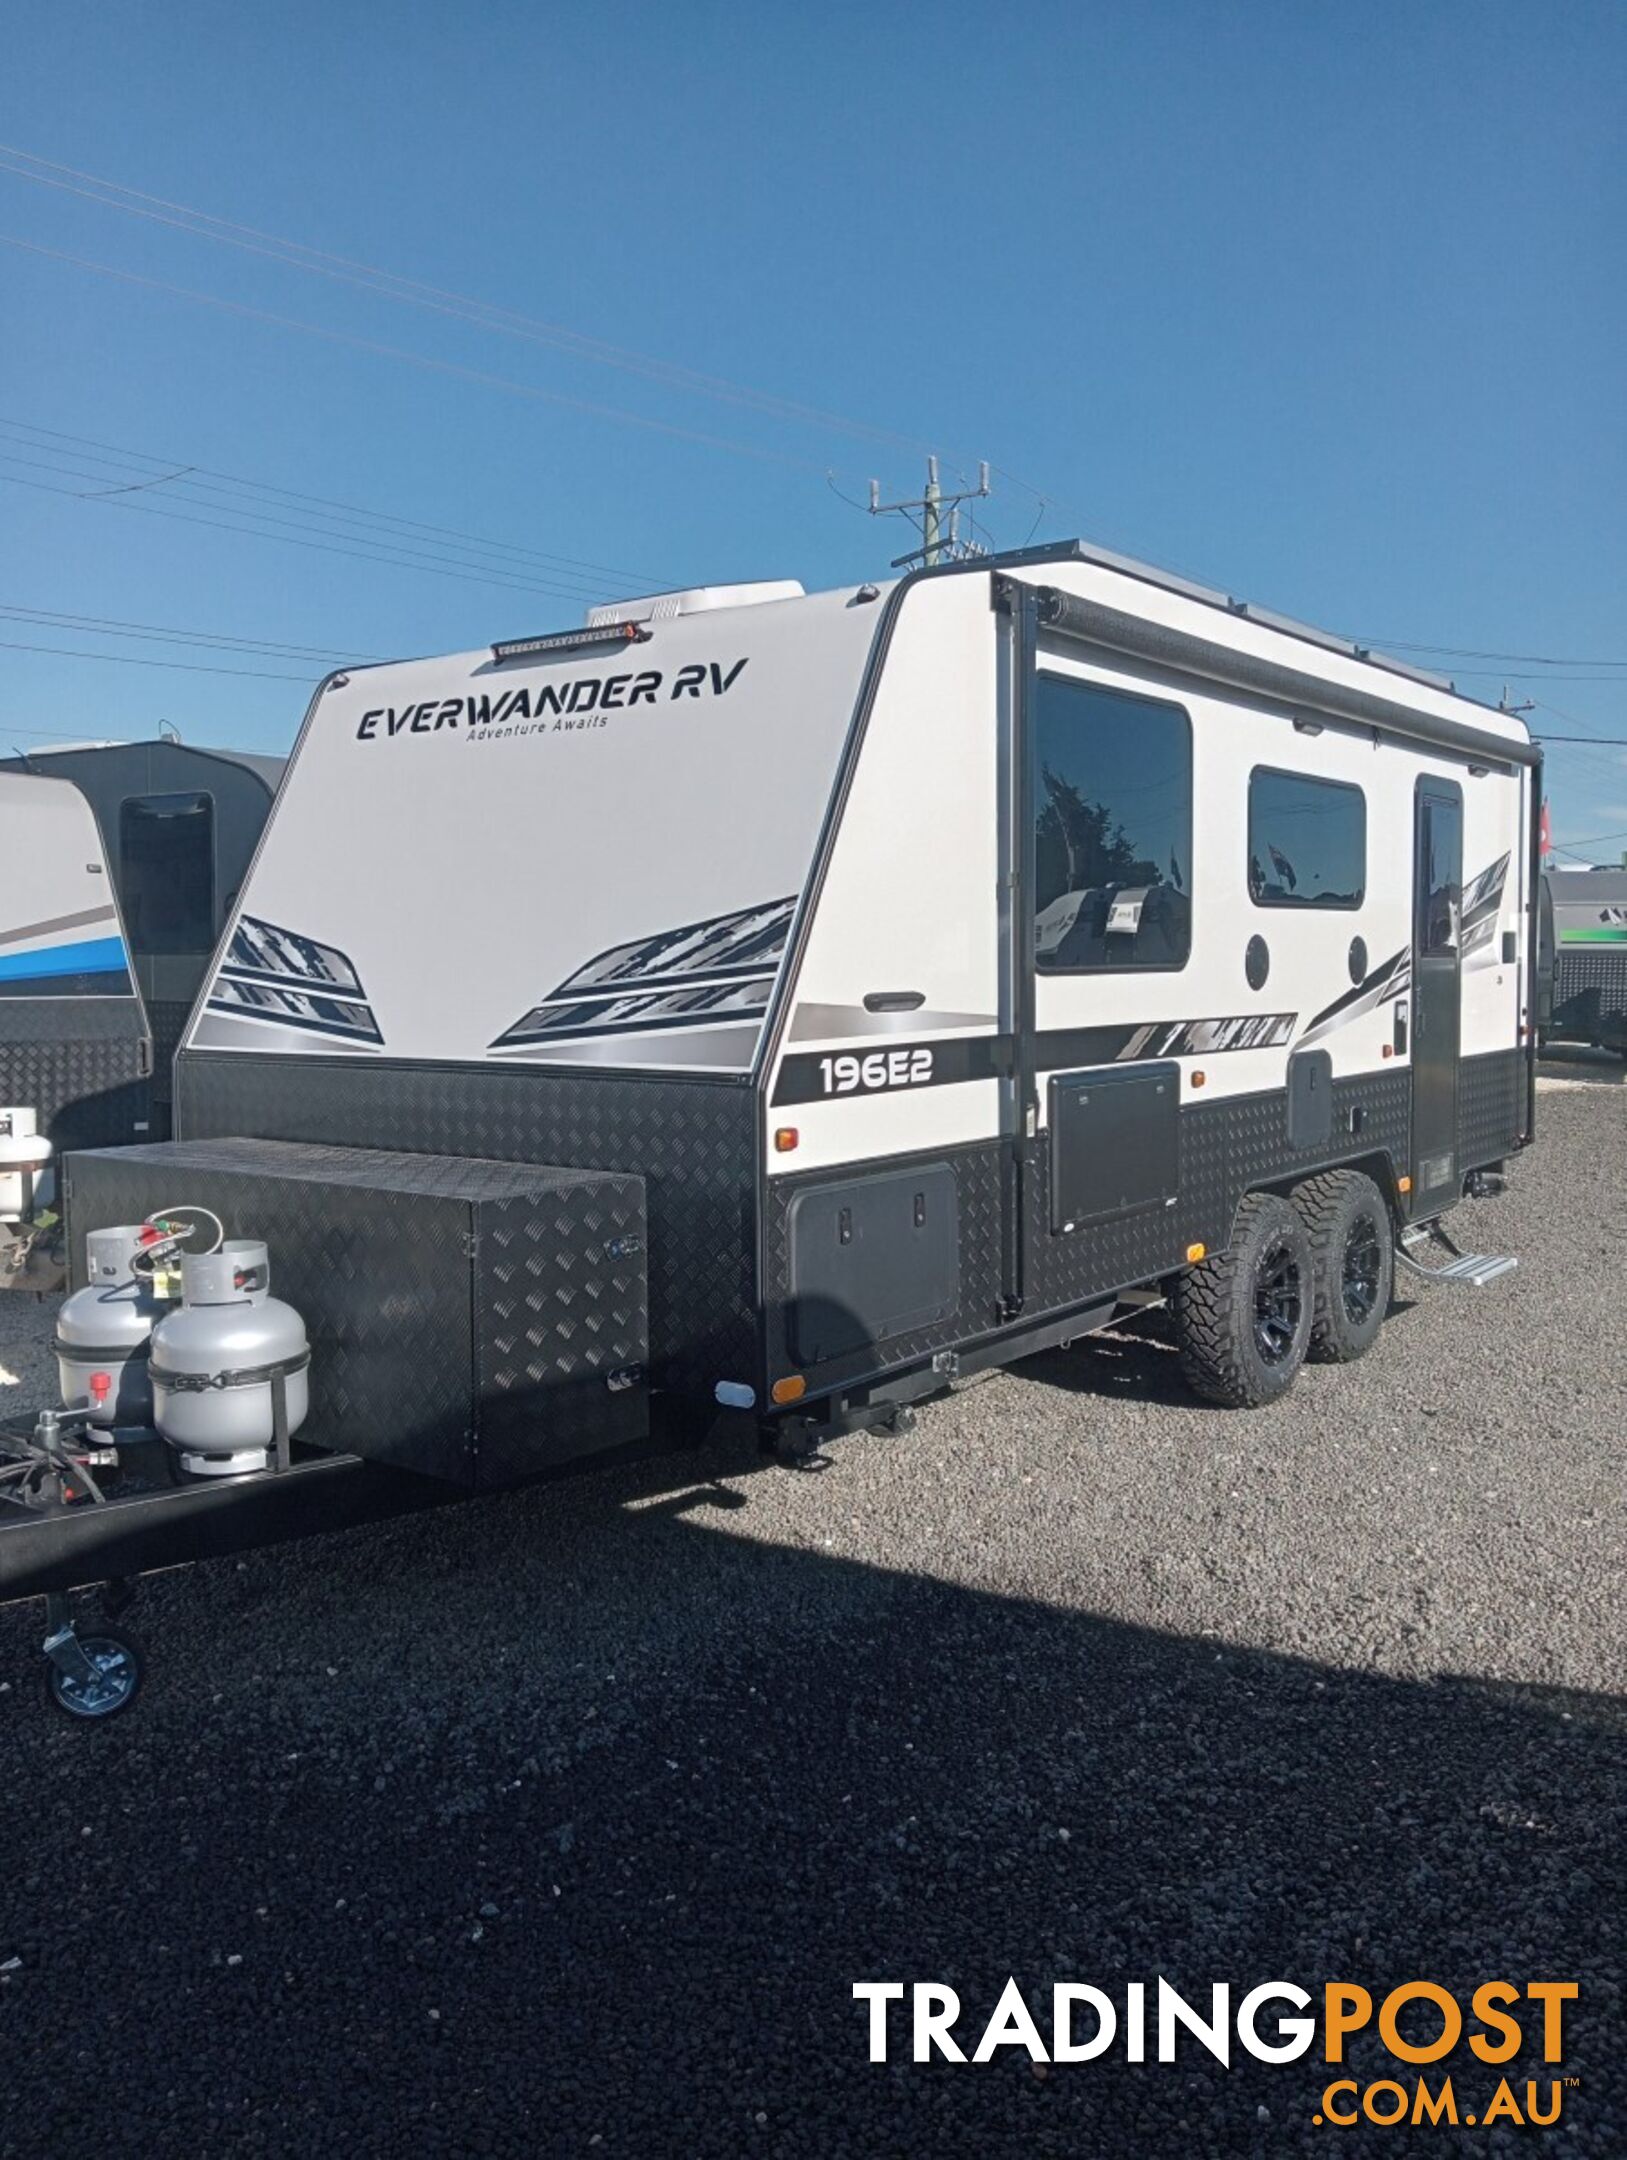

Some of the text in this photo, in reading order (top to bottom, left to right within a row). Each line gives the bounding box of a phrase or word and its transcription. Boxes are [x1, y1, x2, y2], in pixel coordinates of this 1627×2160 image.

[357, 657, 750, 740] EVERWANDER RV
[466, 713, 609, 742] Adventure Awaits
[819, 1049, 933, 1093] 196E2
